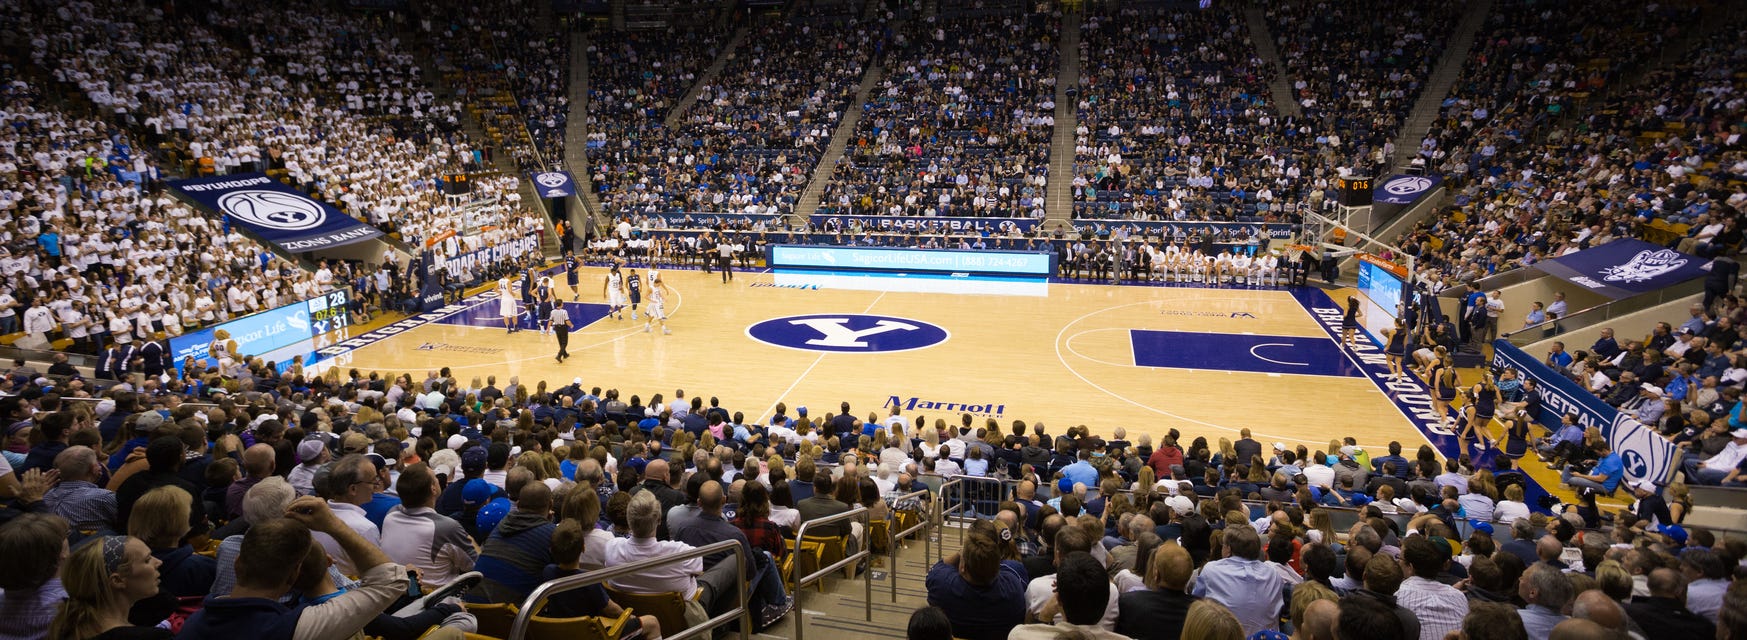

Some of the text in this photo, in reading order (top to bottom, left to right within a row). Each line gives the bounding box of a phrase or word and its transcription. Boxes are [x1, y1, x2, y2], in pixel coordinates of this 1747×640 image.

[182, 176, 271, 192] #BYUHOOPS
[280, 226, 376, 250] ZIONS BANK
[446, 253, 475, 277] ROAR
[477, 248, 492, 268] OF
[330, 291, 346, 307] 28
[264, 320, 287, 337] Life
[317, 304, 468, 356] BRIGHAM
[333, 313, 347, 329] 31
[883, 395, 1005, 414] Marriott
